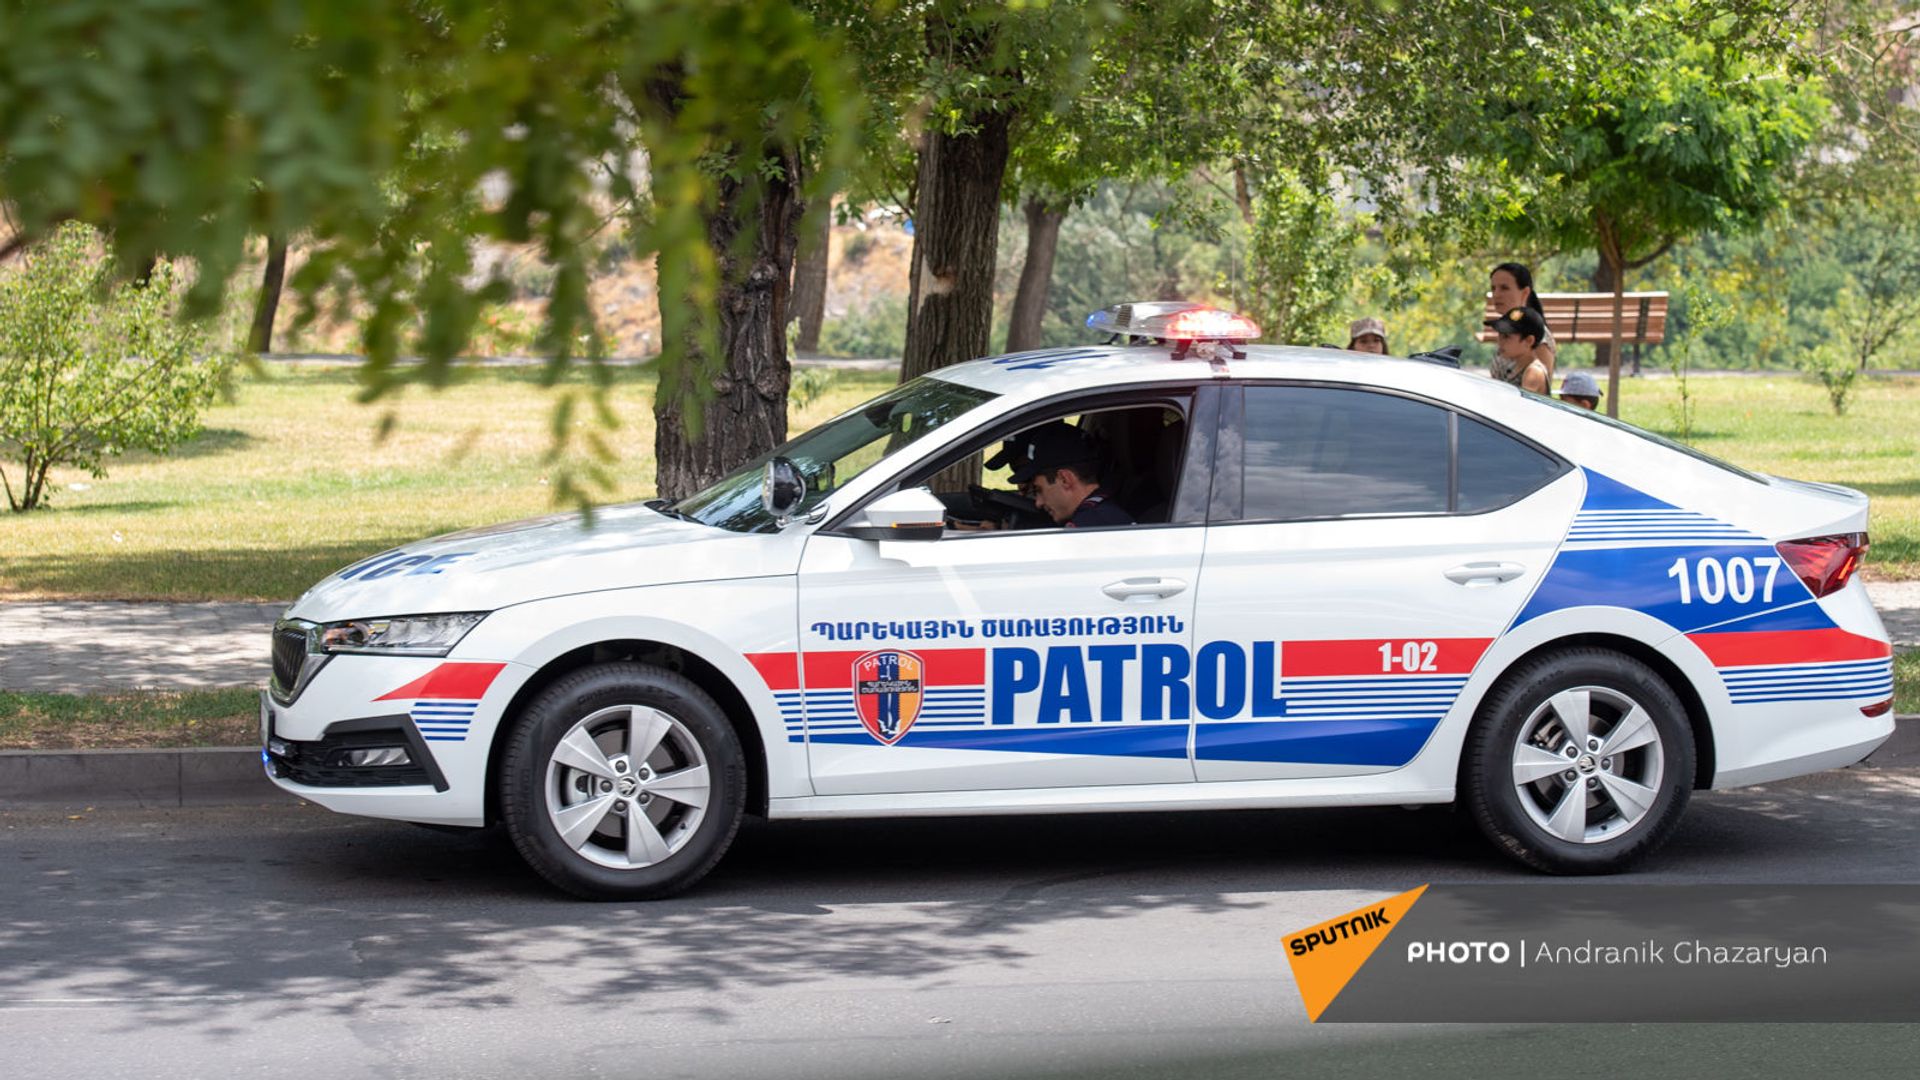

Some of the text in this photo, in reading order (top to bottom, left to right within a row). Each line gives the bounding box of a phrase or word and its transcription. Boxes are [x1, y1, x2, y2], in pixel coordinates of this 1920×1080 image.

[1668, 556, 1781, 604] 1007
[811, 614, 1185, 641] ՊԱՐԵԿԱՅԻՆ ԾԱՌԱՅՈՒԹՅՈՒՆ
[863, 655, 914, 671] PATROL
[1378, 641, 1438, 672] 1-02
[991, 640, 1287, 726] PATROL
